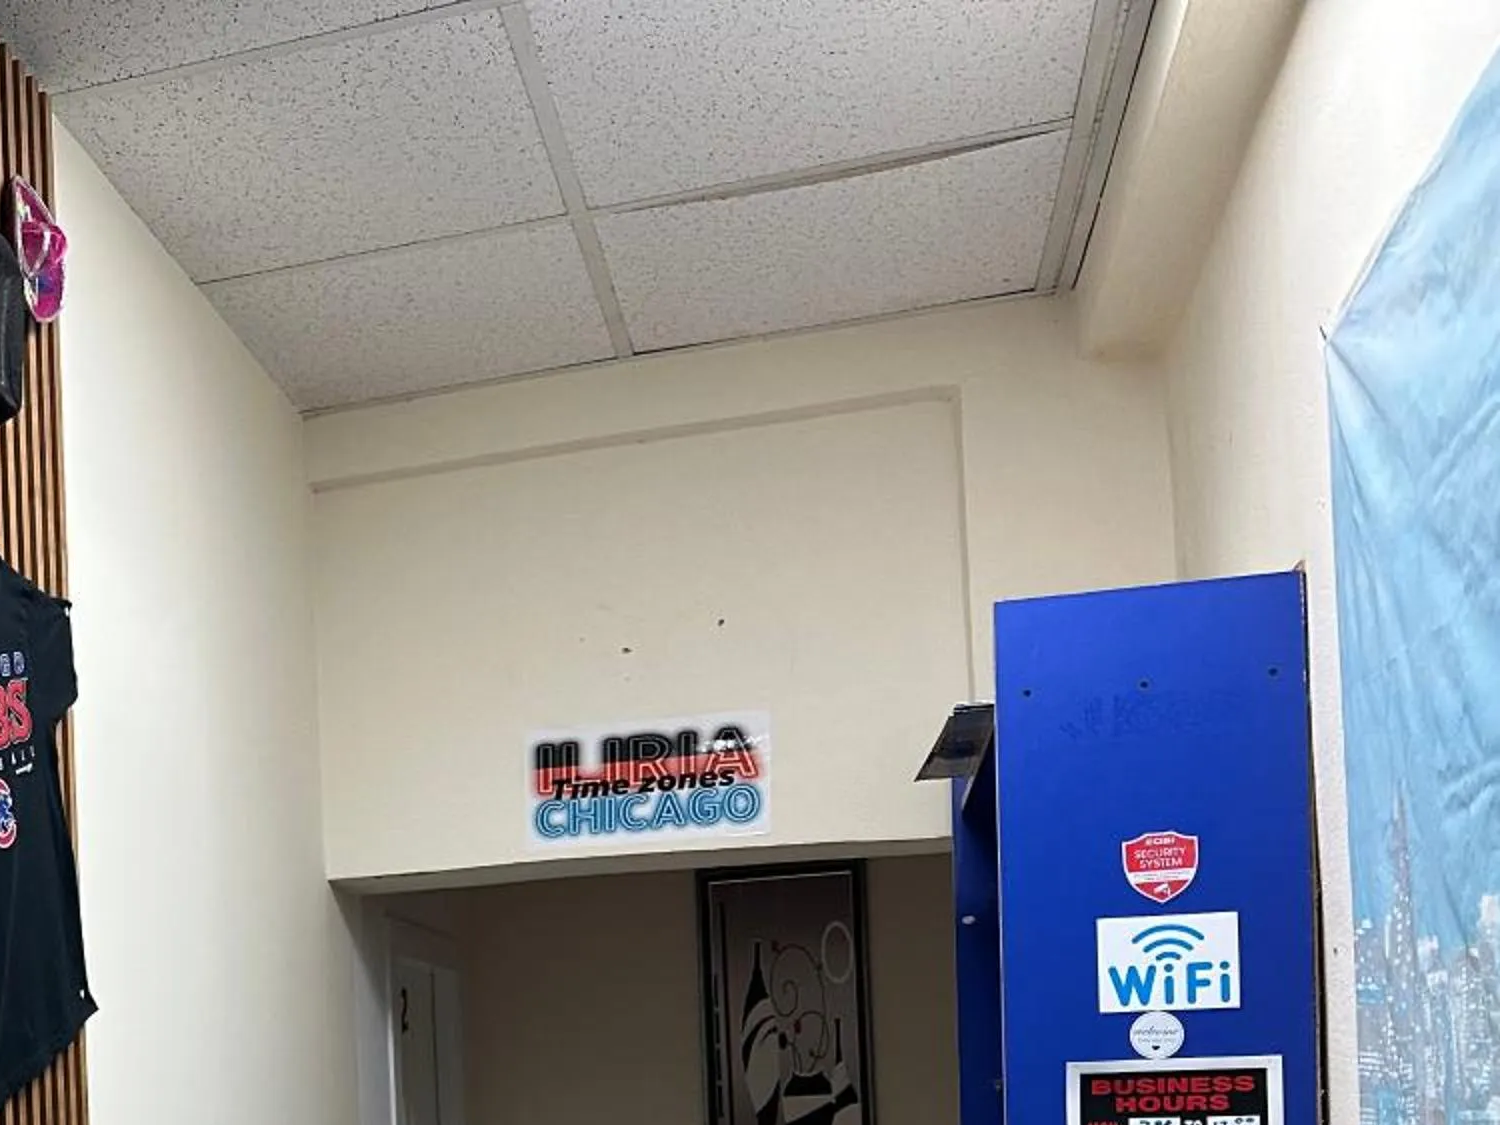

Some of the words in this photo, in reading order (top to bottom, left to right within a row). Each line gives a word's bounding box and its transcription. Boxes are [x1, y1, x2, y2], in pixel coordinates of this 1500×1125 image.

[553, 777, 630, 801] Time
[637, 769, 735, 794] zones
[536, 783, 762, 839] CHICAGO
[1134, 847, 1186, 860] SECURITY
[1139, 857, 1183, 869] SYSTEM
[1108, 961, 1232, 1007] WiFi
[1091, 1075, 1256, 1096] BUSINESS
[1115, 1095, 1231, 1113] HOURS
